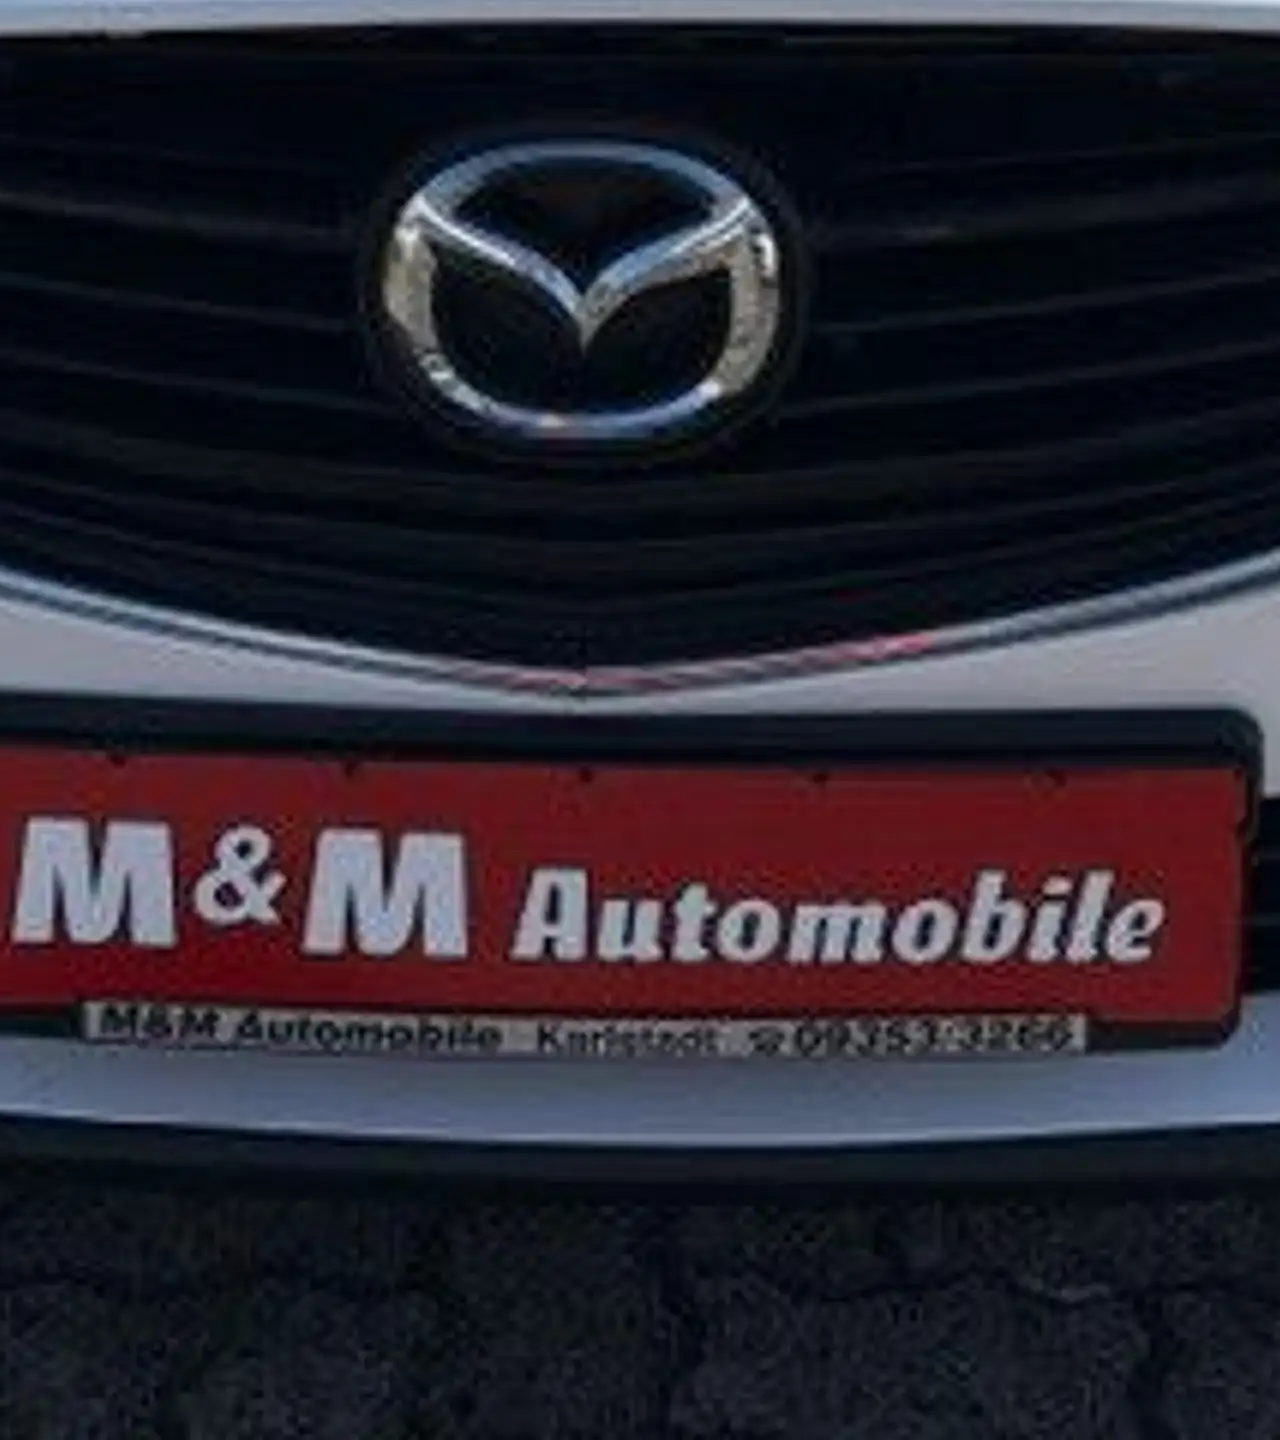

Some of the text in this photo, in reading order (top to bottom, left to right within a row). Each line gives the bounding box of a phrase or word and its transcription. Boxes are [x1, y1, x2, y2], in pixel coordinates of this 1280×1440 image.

[11, 816, 1166, 966] M&M Automobile
[235, 1009, 504, 1052] Automobile
